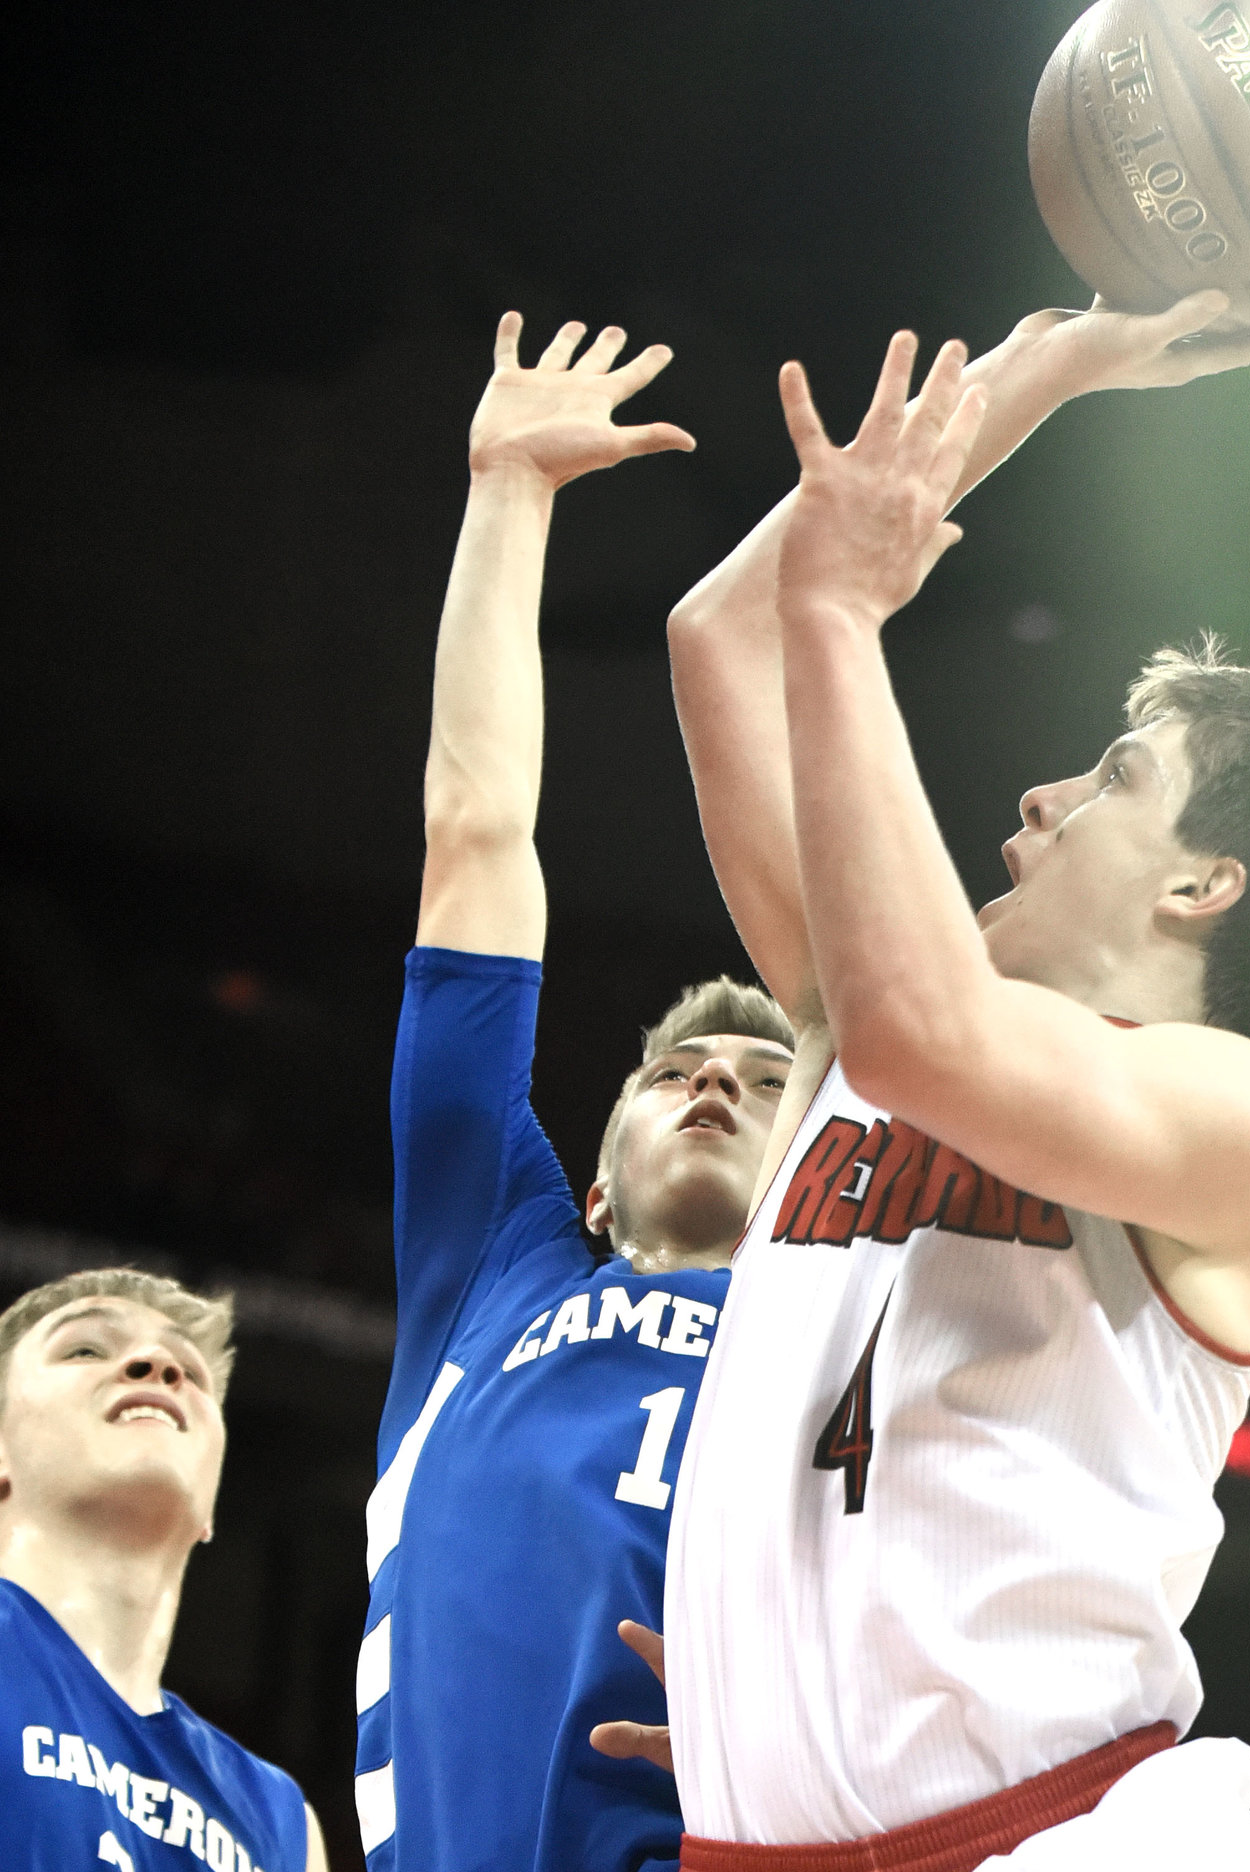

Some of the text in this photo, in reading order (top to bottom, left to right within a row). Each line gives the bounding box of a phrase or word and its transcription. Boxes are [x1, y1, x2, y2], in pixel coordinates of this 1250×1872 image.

[502, 1286, 724, 1372] CAME
[614, 1386, 685, 1510] 1
[813, 1275, 897, 1515] 4
